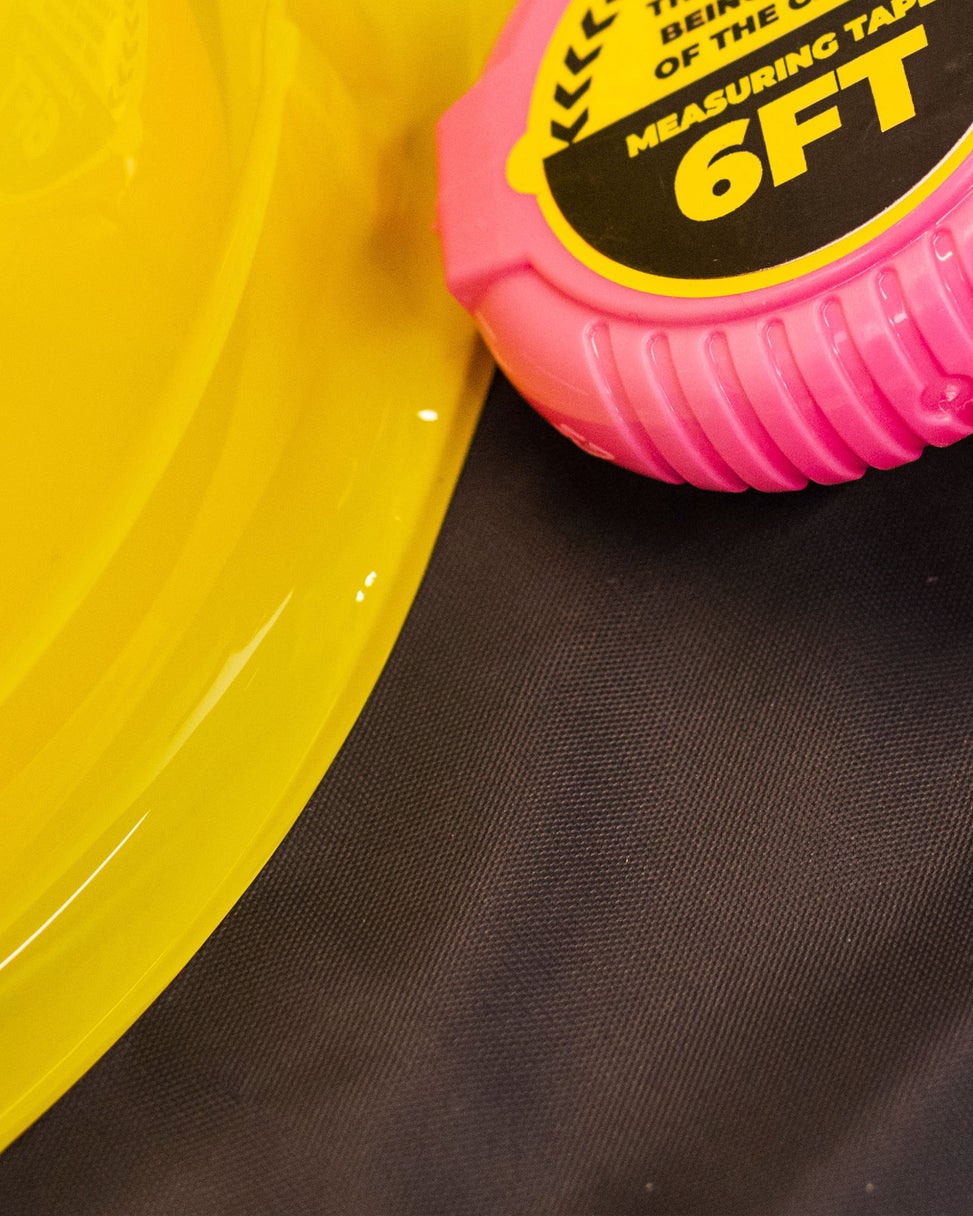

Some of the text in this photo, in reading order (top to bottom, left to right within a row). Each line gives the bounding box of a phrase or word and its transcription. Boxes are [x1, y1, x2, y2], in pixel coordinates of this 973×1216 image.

[625, 32, 840, 158] MEASURING
[654, 43, 701, 80] OF
[709, 4, 779, 50] THE
[673, 23, 929, 222] 6FT
